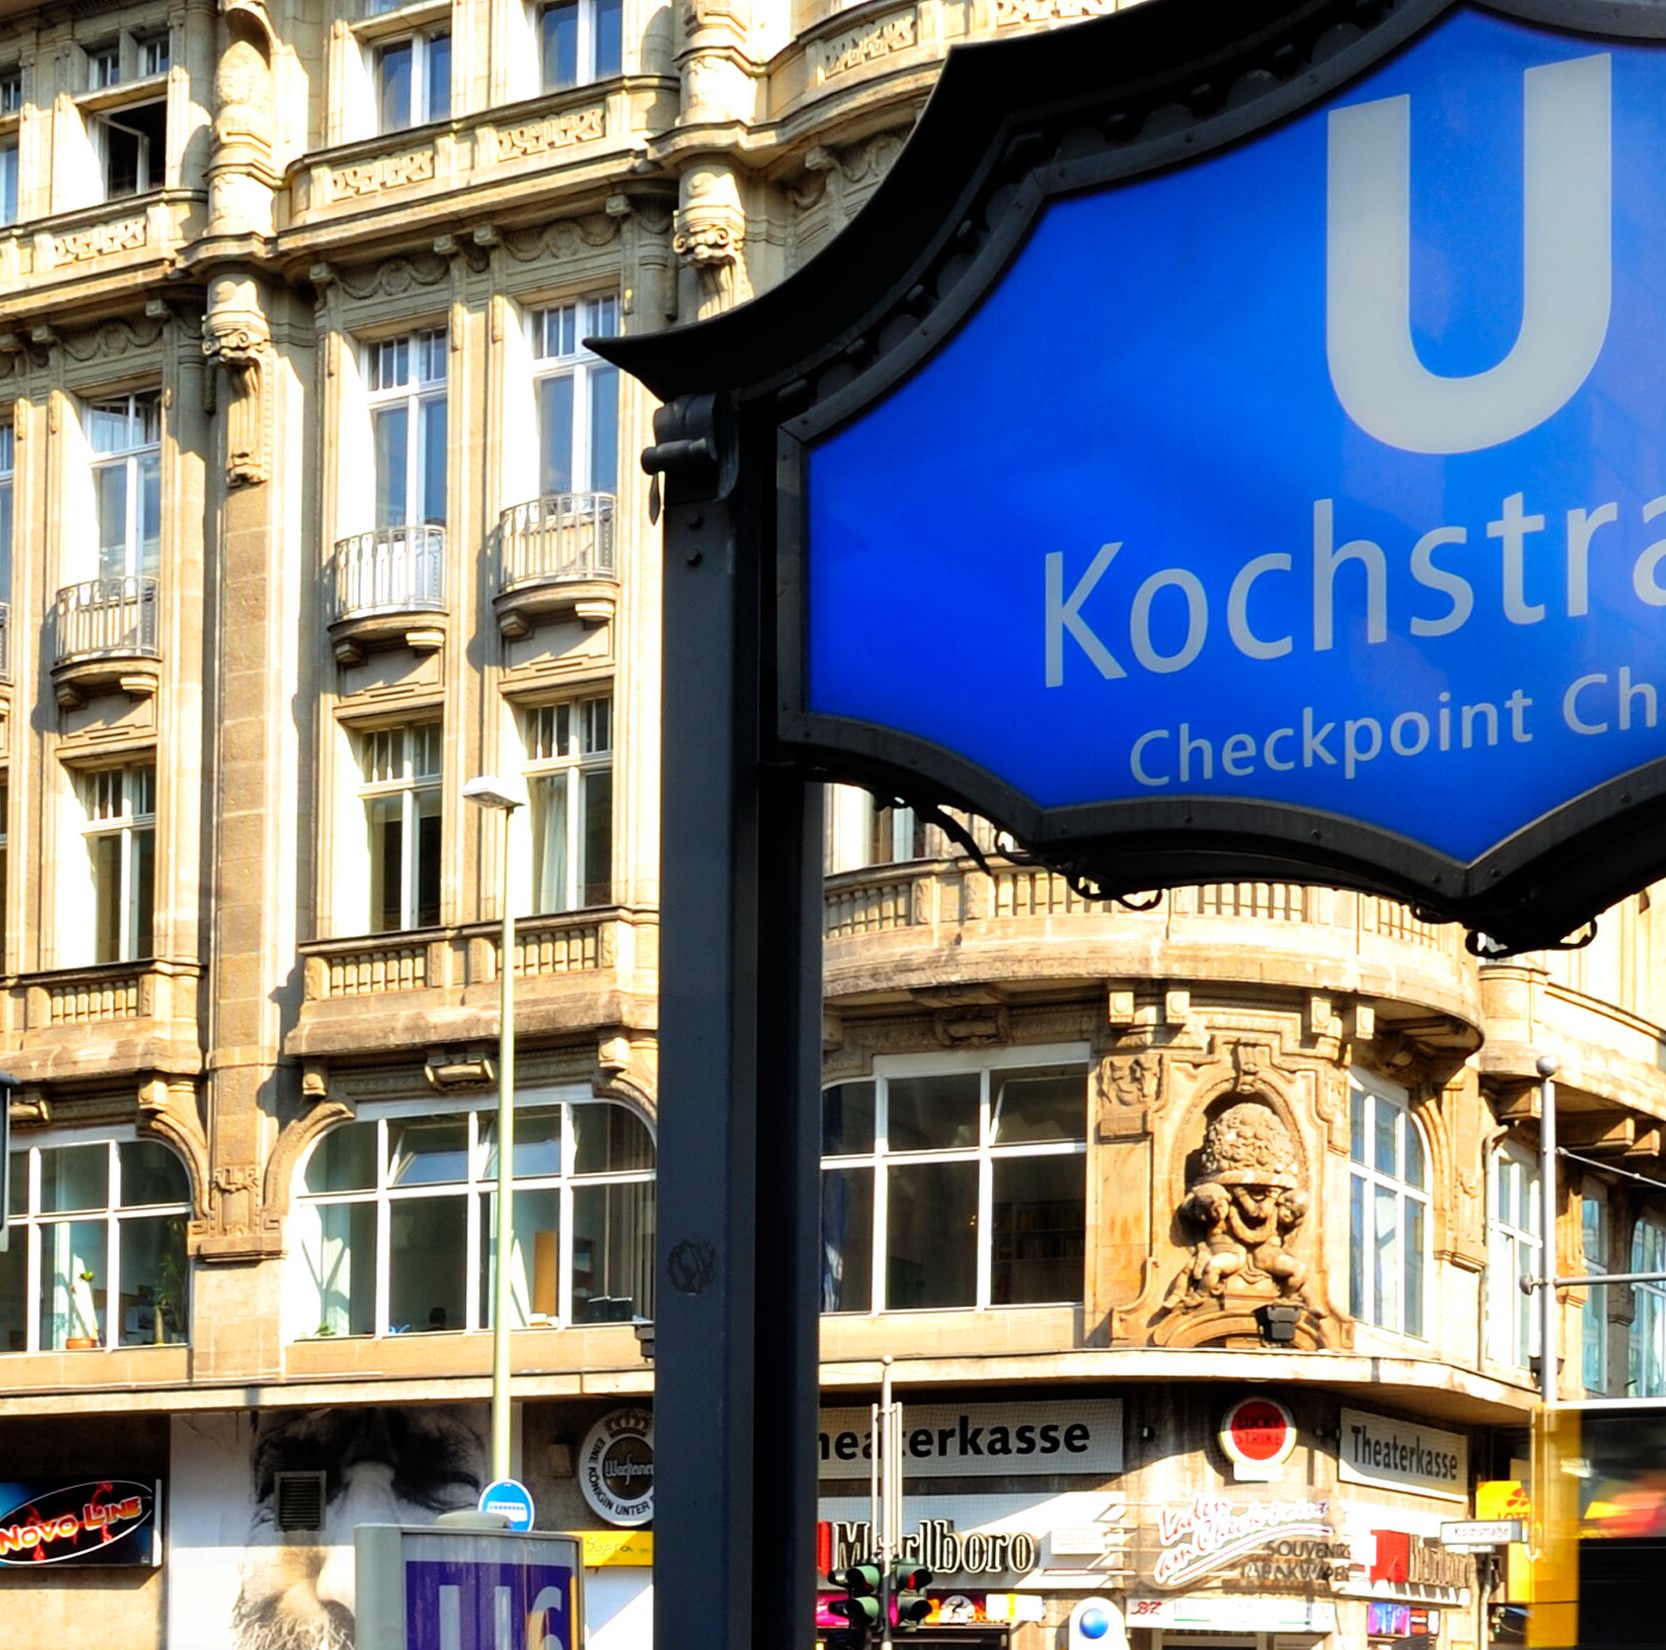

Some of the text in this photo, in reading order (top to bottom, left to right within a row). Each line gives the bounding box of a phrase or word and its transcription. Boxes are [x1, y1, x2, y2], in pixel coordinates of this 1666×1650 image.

[1328, 54, 1612, 454] U
[1130, 690, 1533, 789] Checkpoint
[1236, 1431, 1281, 1447] STRIKE
[1237, 1414, 1282, 1430] LUCKY
[588, 1436, 606, 1465] EINE
[1351, 1425, 1458, 1481] Theaterkasse
[588, 1466, 651, 1517] KÖNIGIN UNTER
[833, 1519, 1036, 1573] Mrlboro
